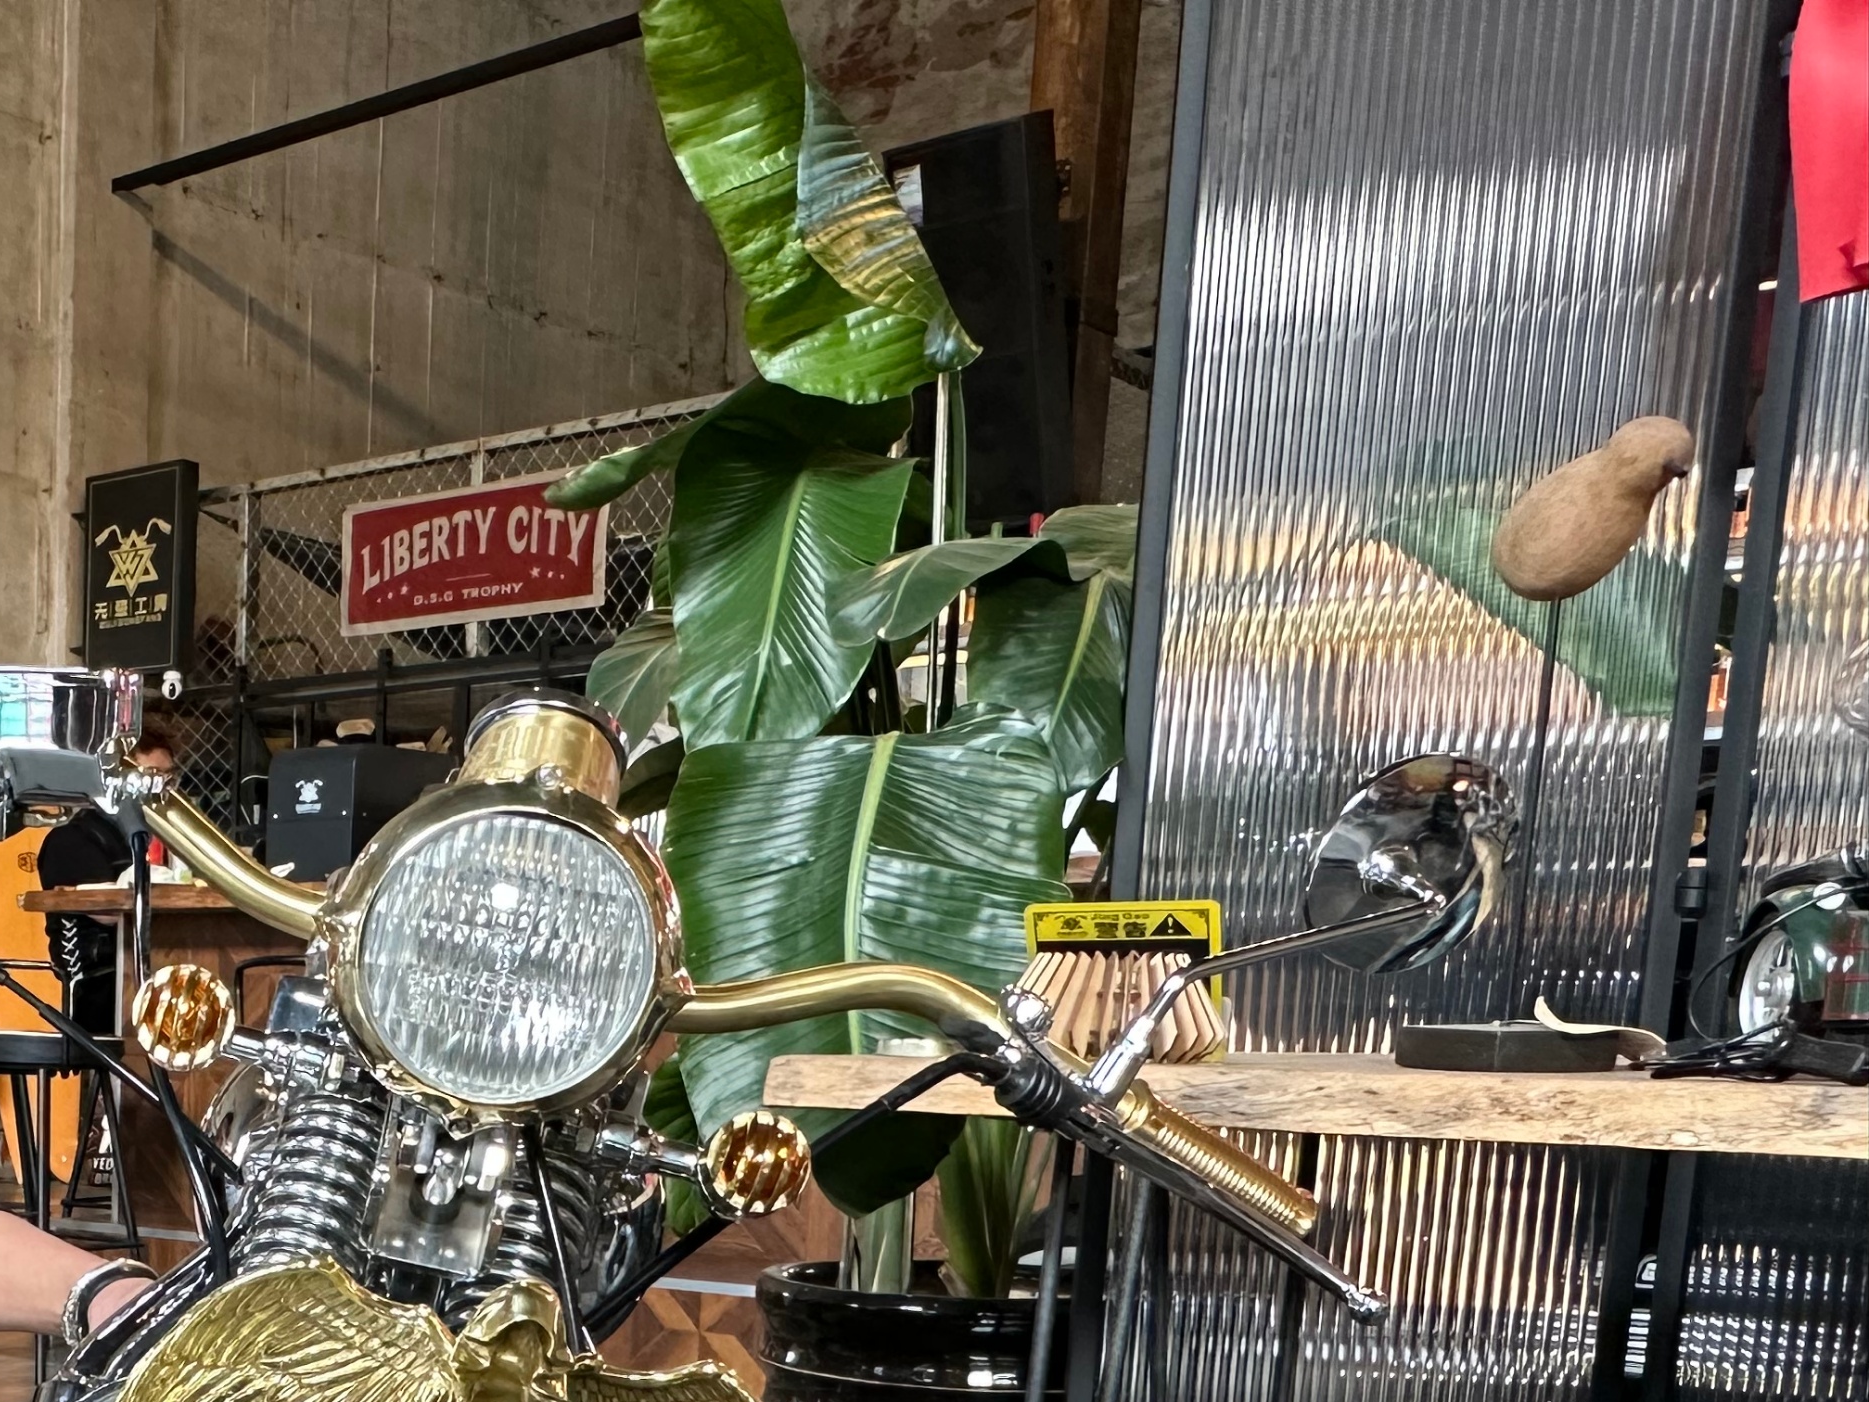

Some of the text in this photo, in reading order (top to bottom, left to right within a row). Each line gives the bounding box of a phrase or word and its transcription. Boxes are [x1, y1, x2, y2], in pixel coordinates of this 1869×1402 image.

[361, 504, 590, 596] LIBERTY CITY
[462, 581, 524, 600] TROPHY
